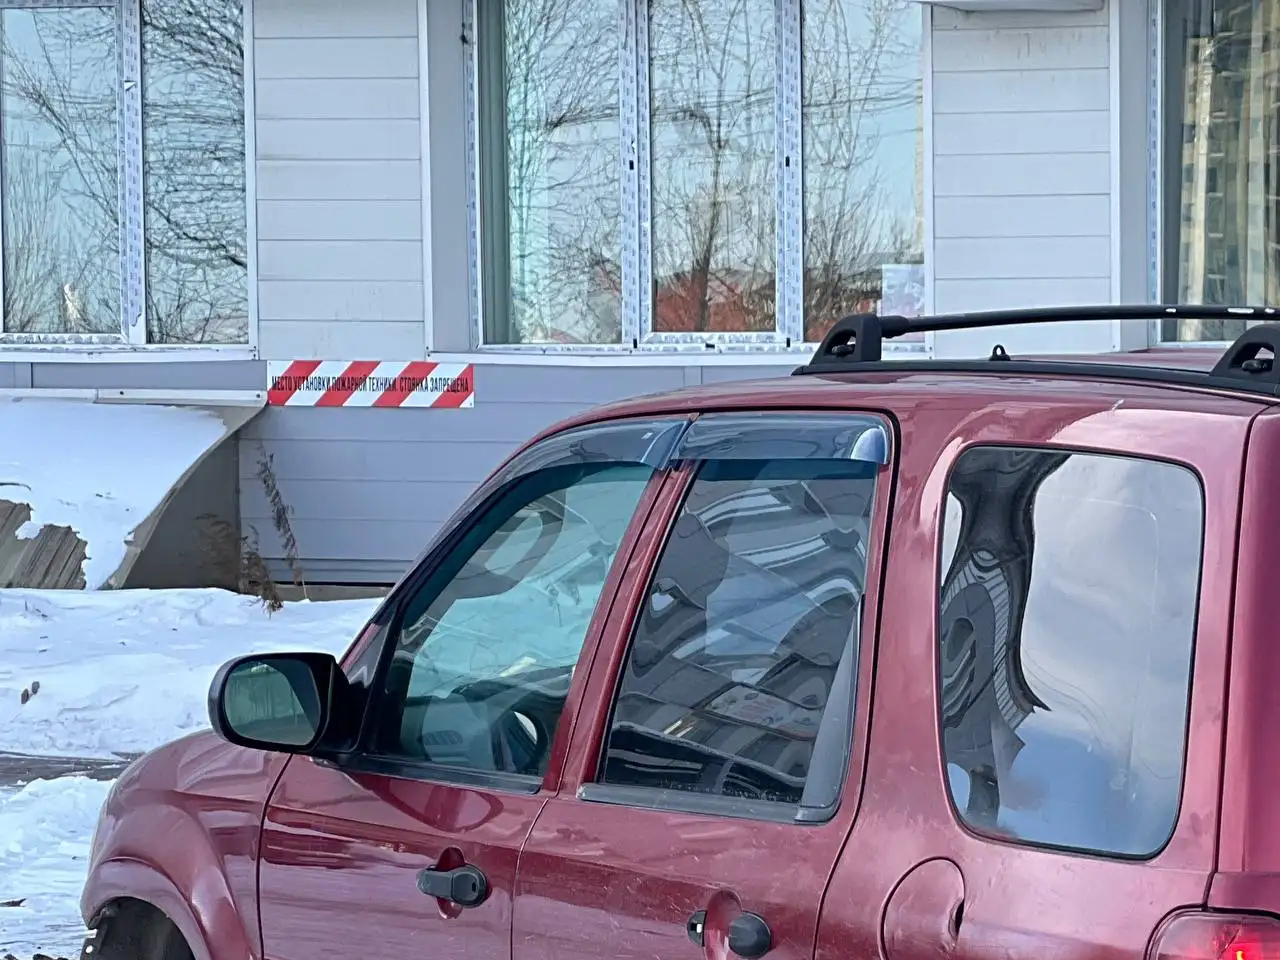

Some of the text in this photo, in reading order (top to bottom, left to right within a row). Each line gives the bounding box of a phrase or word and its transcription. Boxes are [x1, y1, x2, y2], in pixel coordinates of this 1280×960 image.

[271, 375, 292, 392] МЕСТО
[293, 375, 330, 392] УСТАНОВКИ
[331, 374, 367, 392] ПОЖАРНОЙ
[400, 376, 428, 392] СТОЯНКА
[430, 376, 469, 393] ЗАПРЕЩЕНА
